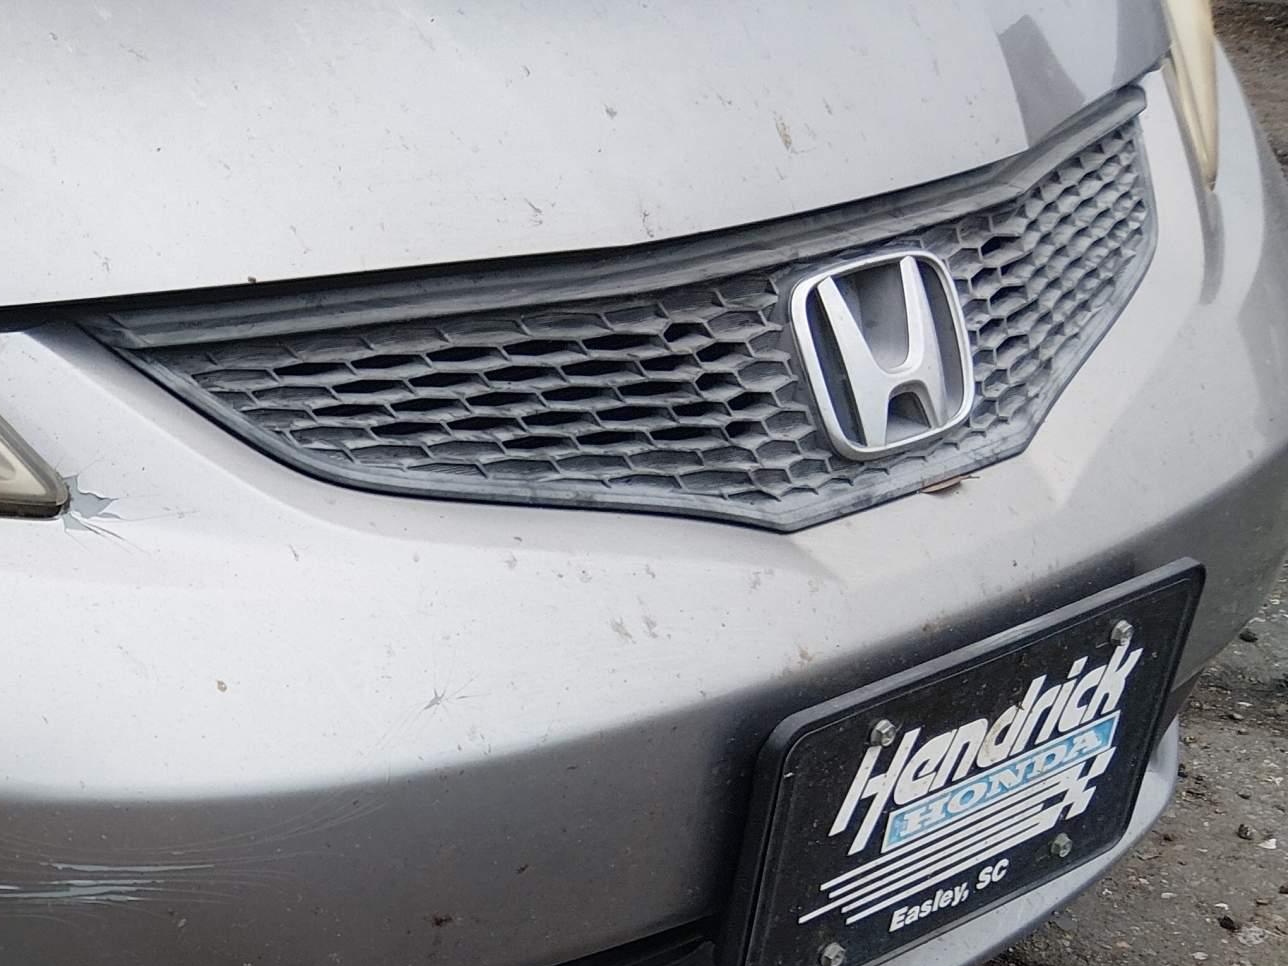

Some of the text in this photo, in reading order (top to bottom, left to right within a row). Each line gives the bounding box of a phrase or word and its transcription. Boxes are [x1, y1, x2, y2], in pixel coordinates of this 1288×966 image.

[828, 645, 1143, 855] Hendrick
[898, 728, 1103, 838] HONDA
[889, 858, 1009, 932] Easley, SC
